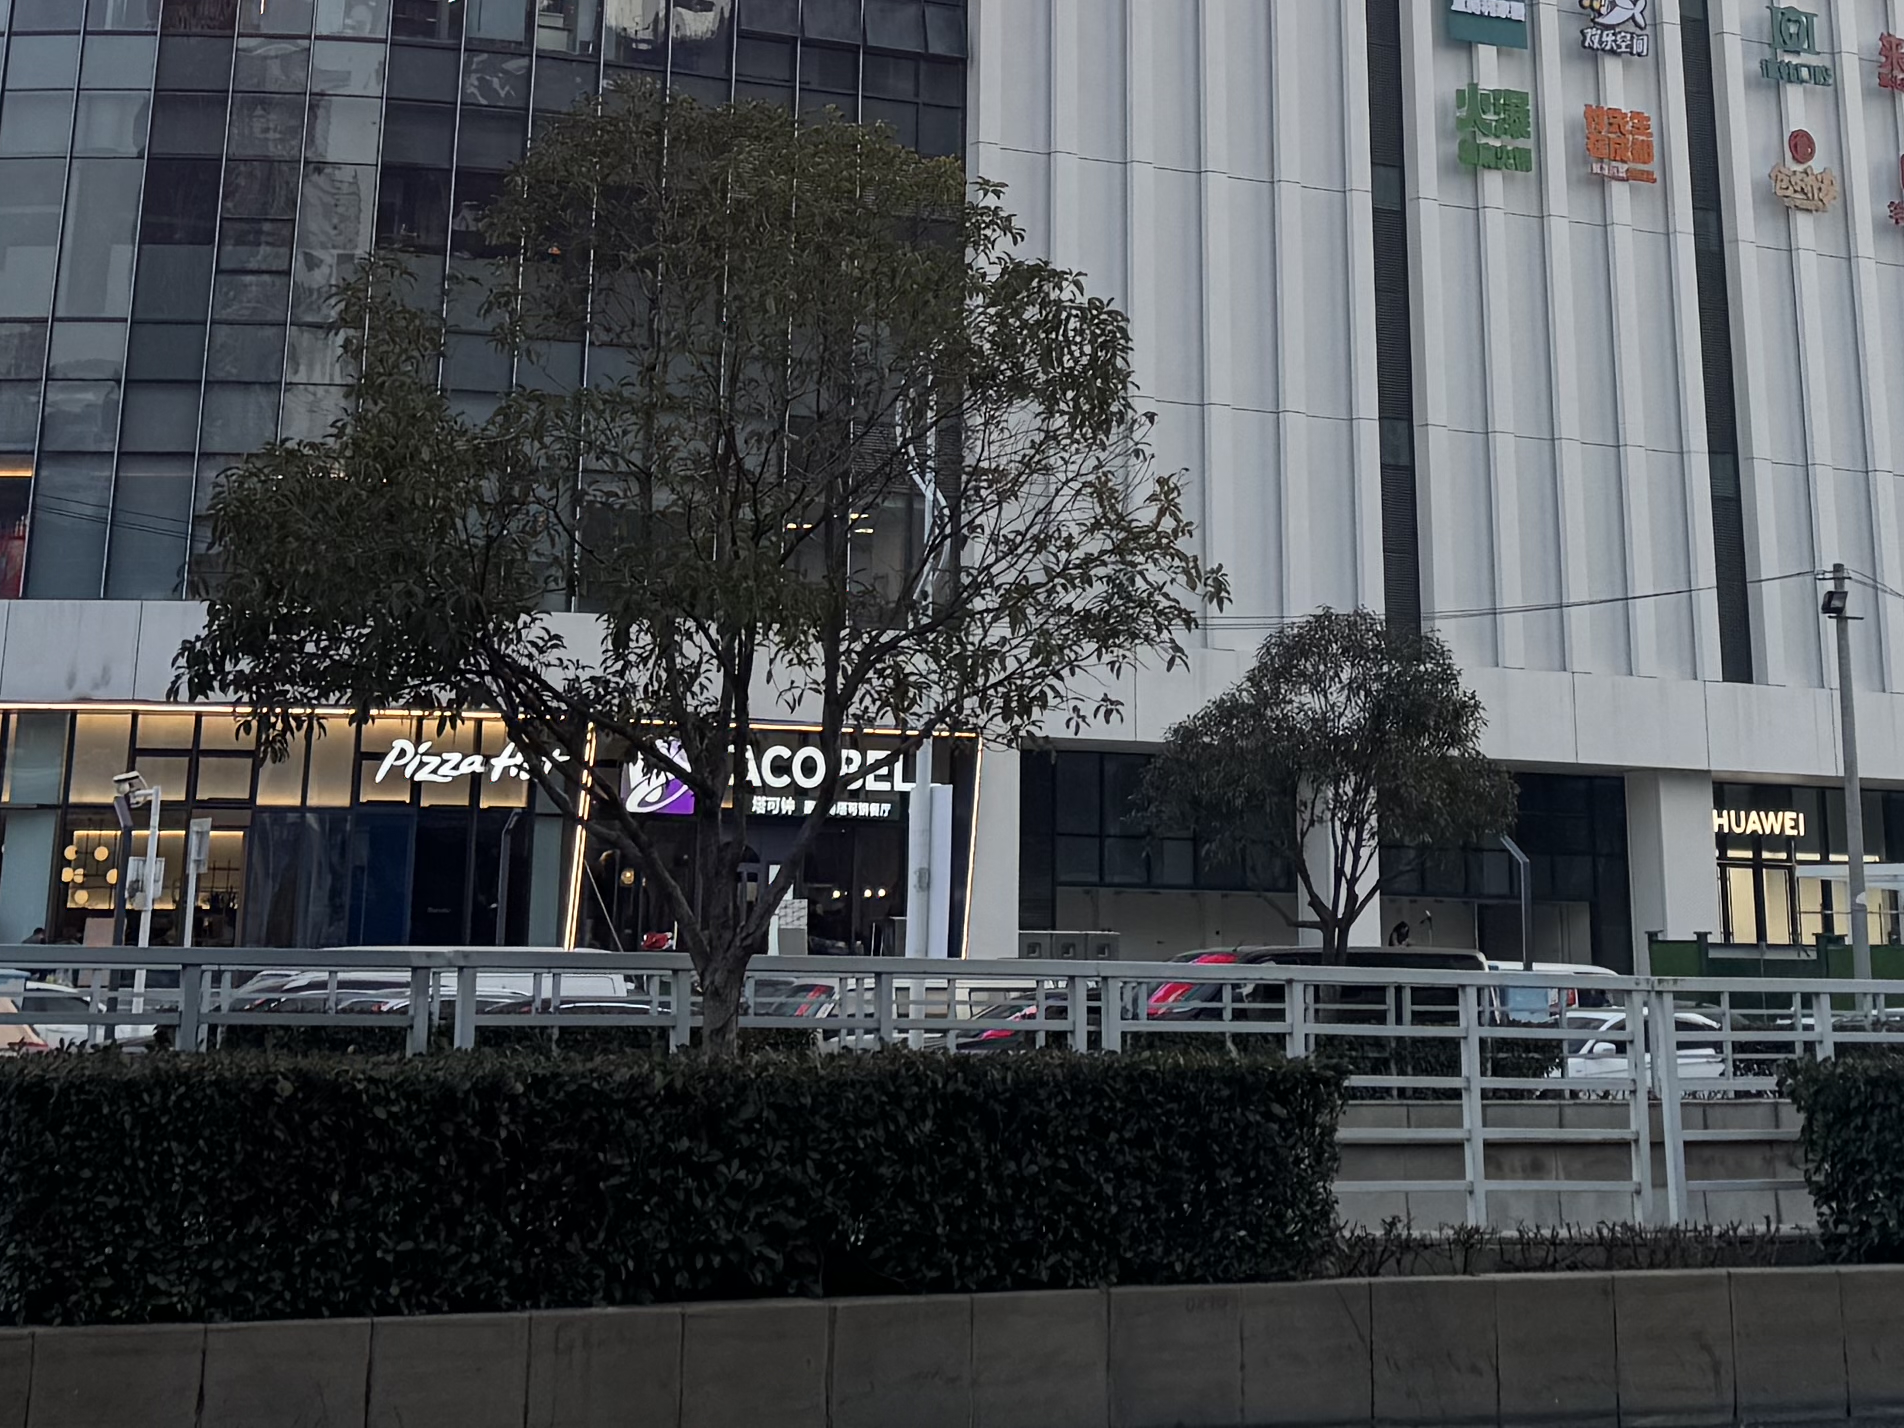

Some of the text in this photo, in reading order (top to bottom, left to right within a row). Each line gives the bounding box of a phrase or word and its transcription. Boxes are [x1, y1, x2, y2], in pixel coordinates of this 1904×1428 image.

[375, 739, 486, 784] Pizza
[726, 744, 827, 789] ACO
[752, 795, 796, 816] 塔可钟
[1712, 809, 1805, 836] HUAWEI
